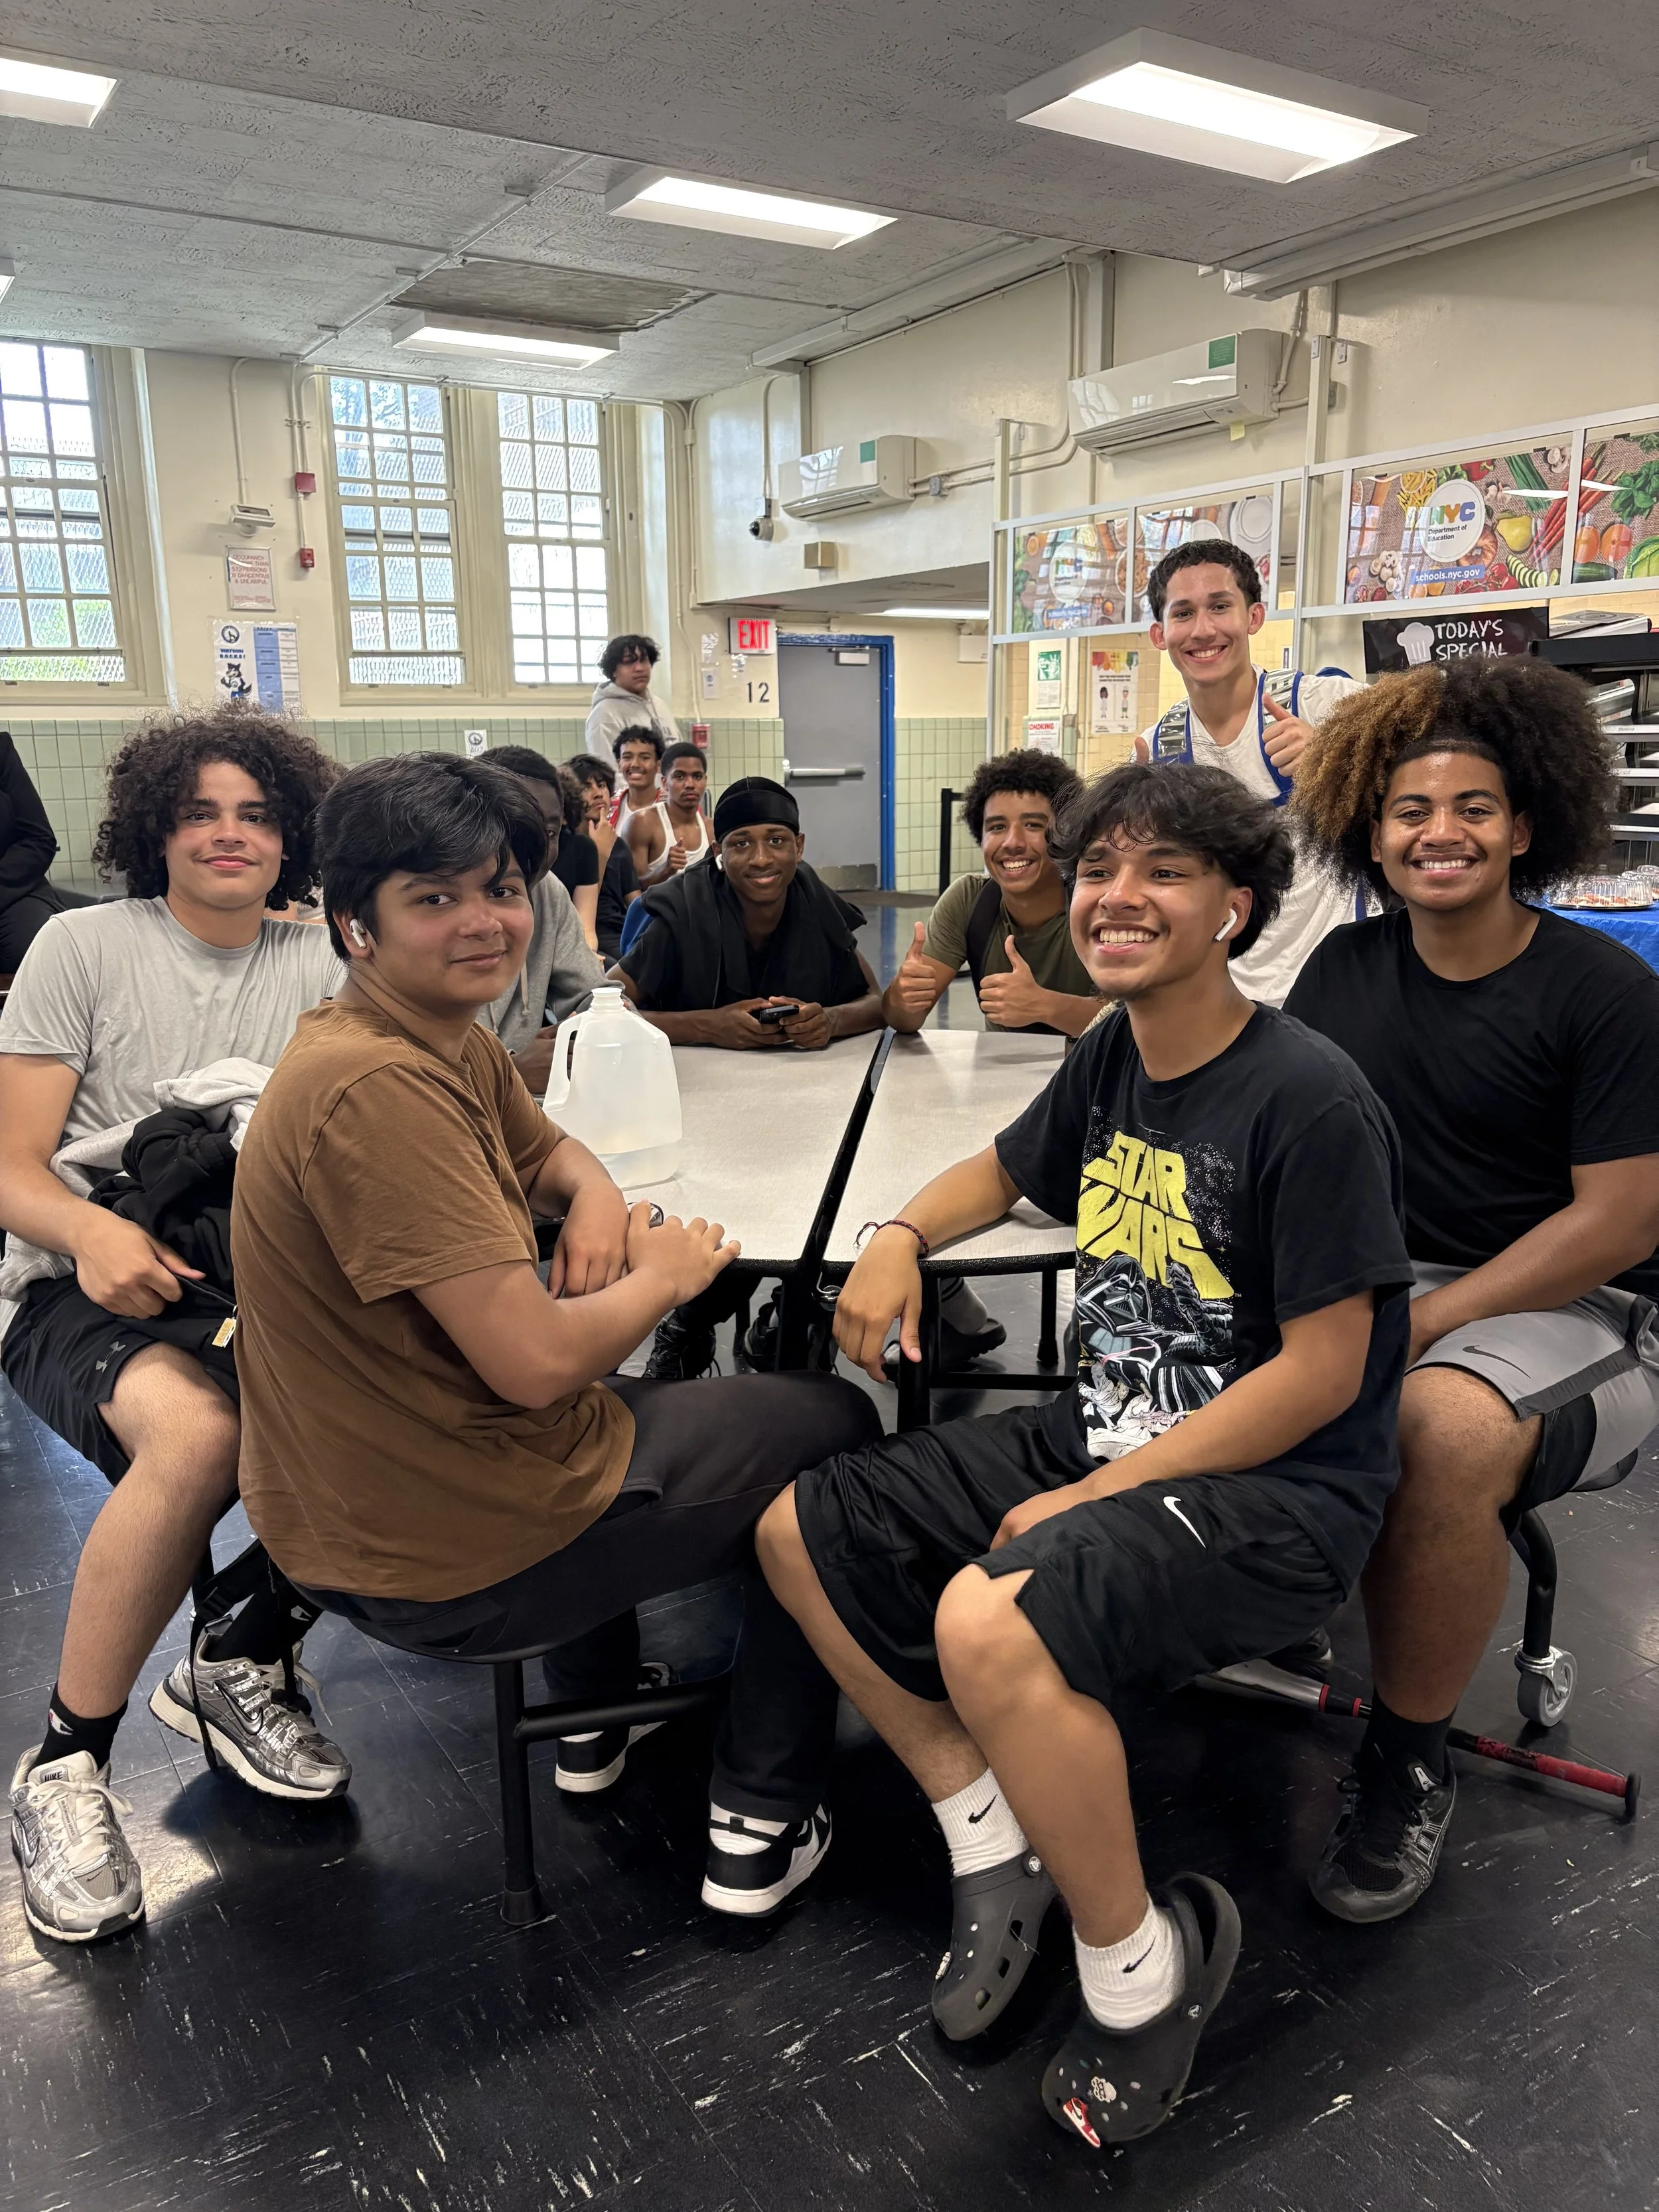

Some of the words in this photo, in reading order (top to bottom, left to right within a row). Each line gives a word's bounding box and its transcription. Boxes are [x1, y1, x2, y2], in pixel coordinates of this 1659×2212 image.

[1429, 501, 1476, 526] NYC
[1427, 526, 1460, 535] Department
[1415, 568, 1480, 582] schools.nyc.gov
[738, 620, 770, 650] EXIT
[1434, 619, 1504, 639] TODAY'S
[1435, 640, 1508, 661] SPECIAL
[747, 682, 770, 703] 12
[1082, 1130, 1193, 1222] STAR
[1076, 1178, 1234, 1299] WARS
[44, 1771, 63, 1782] NIKE
